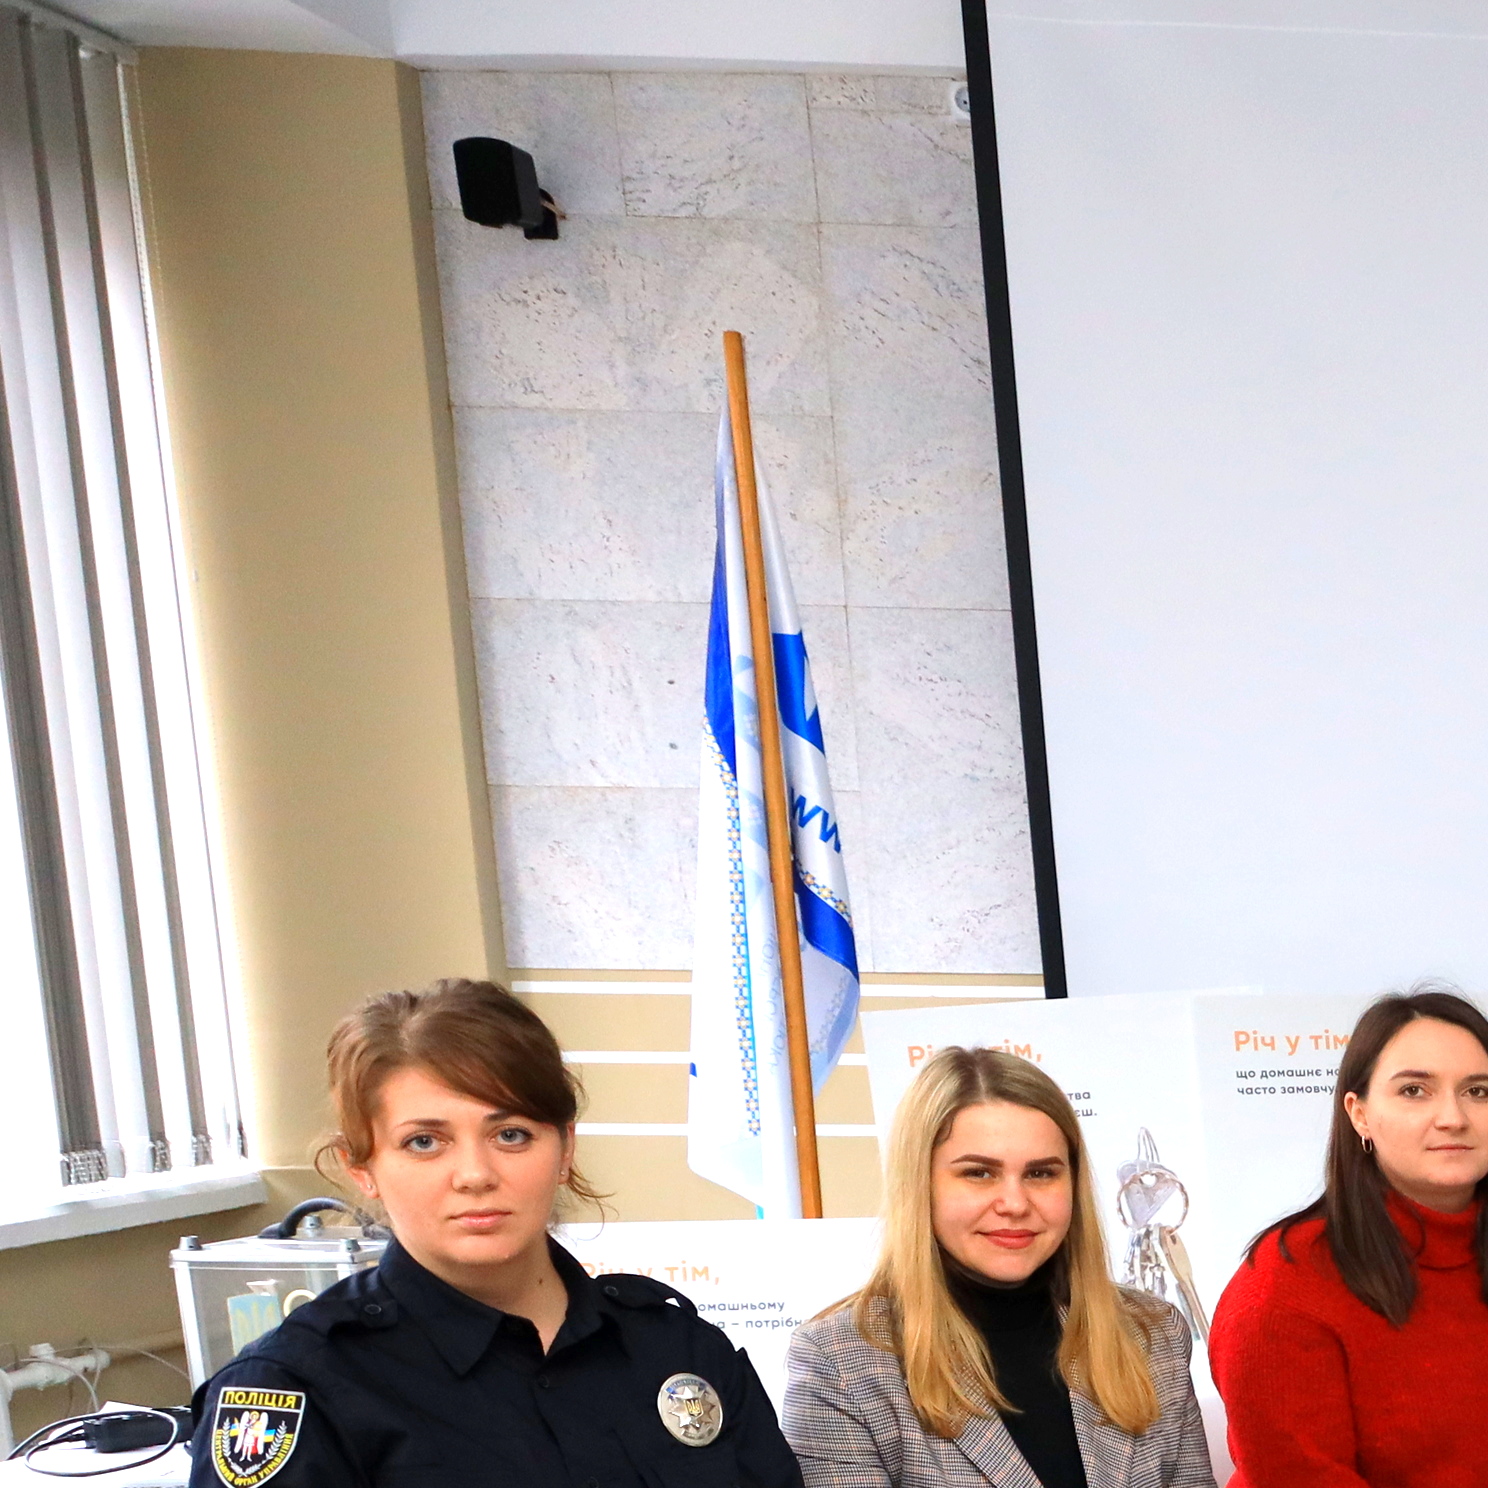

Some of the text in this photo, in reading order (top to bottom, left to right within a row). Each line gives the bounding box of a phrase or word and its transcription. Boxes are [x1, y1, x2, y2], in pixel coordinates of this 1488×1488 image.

[1234, 1029, 1350, 1056] Річ у тім
[1236, 1070, 1256, 1080] що
[1260, 1068, 1322, 1080] домашнє
[1237, 1084, 1334, 1096] часто замовчу
[664, 1260, 721, 1285] тім,
[697, 1301, 785, 1313] омашньому
[745, 1316, 802, 1331] потрібн
[224, 1391, 297, 1409] ПОЛІЦІЯ
